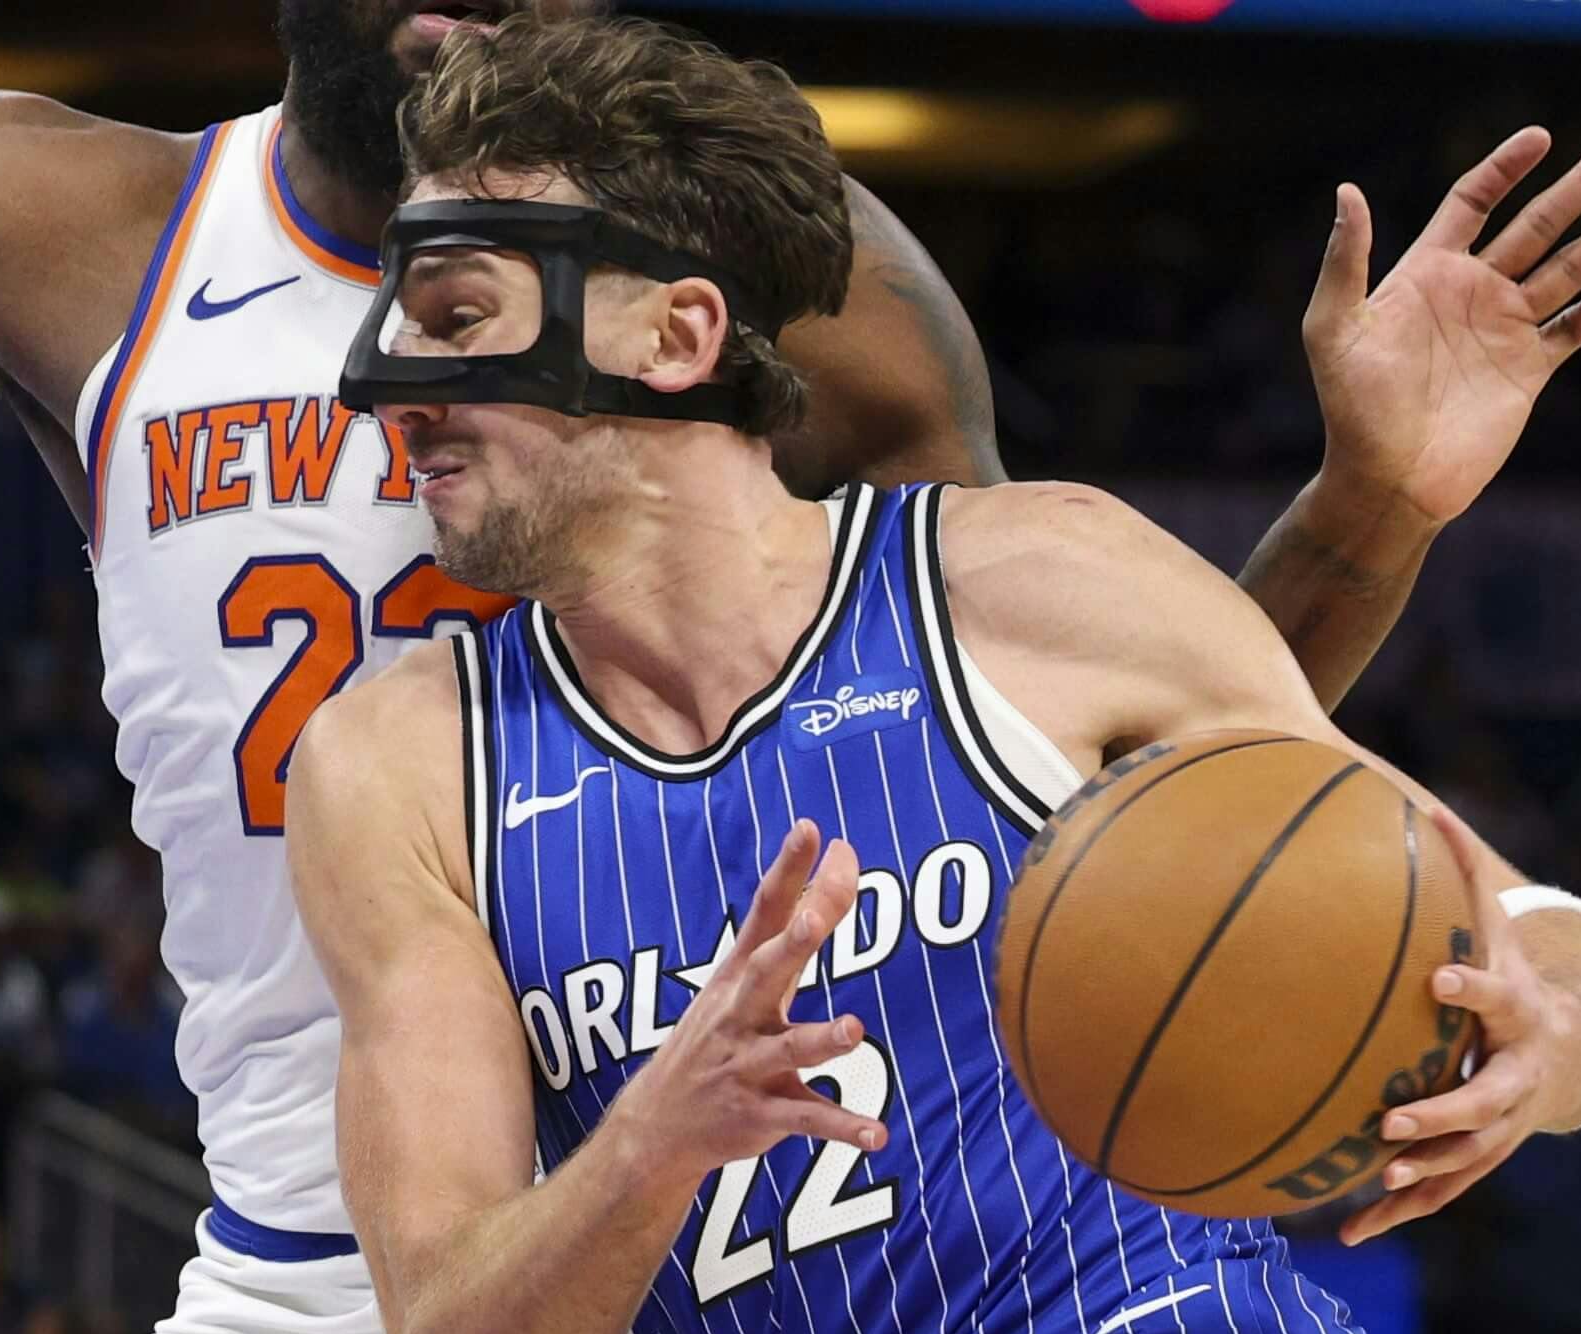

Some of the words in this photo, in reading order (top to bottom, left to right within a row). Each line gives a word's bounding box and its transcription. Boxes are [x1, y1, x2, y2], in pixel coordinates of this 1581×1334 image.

[142, 394, 355, 538] NEW
[788, 684, 921, 737] Disney
[518, 838, 993, 1095] ORLDO
